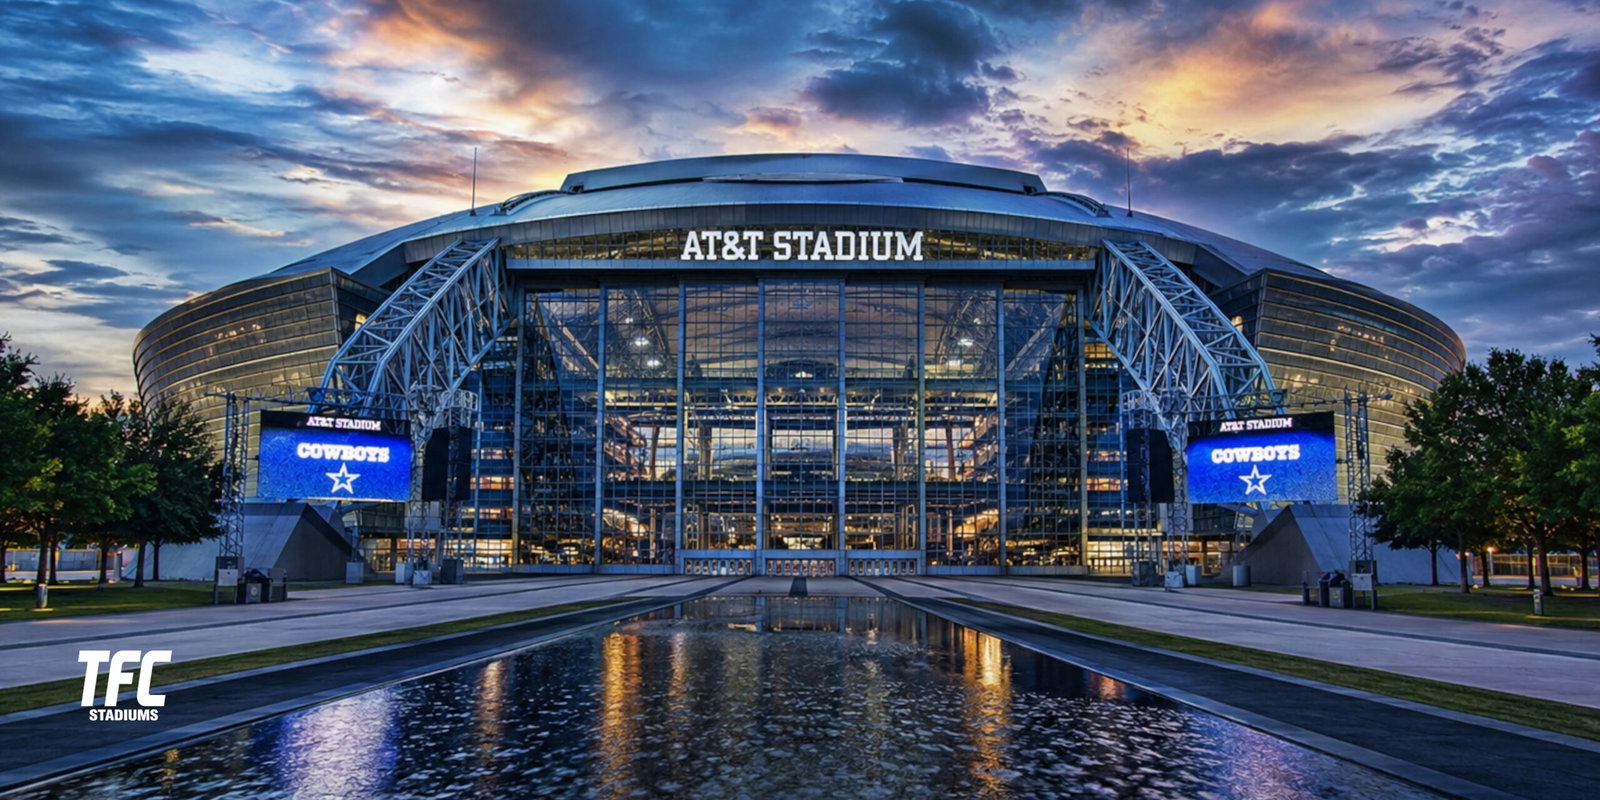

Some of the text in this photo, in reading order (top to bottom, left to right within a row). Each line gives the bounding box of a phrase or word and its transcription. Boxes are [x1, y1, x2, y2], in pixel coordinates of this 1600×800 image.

[681, 231, 923, 260] AT&T STADIUM
[306, 416, 381, 431] AT&T STADIUM
[1220, 418, 1293, 432] AT&T STADIUM
[297, 442, 390, 463] COWBOYS
[1211, 444, 1300, 464] COWBOYS
